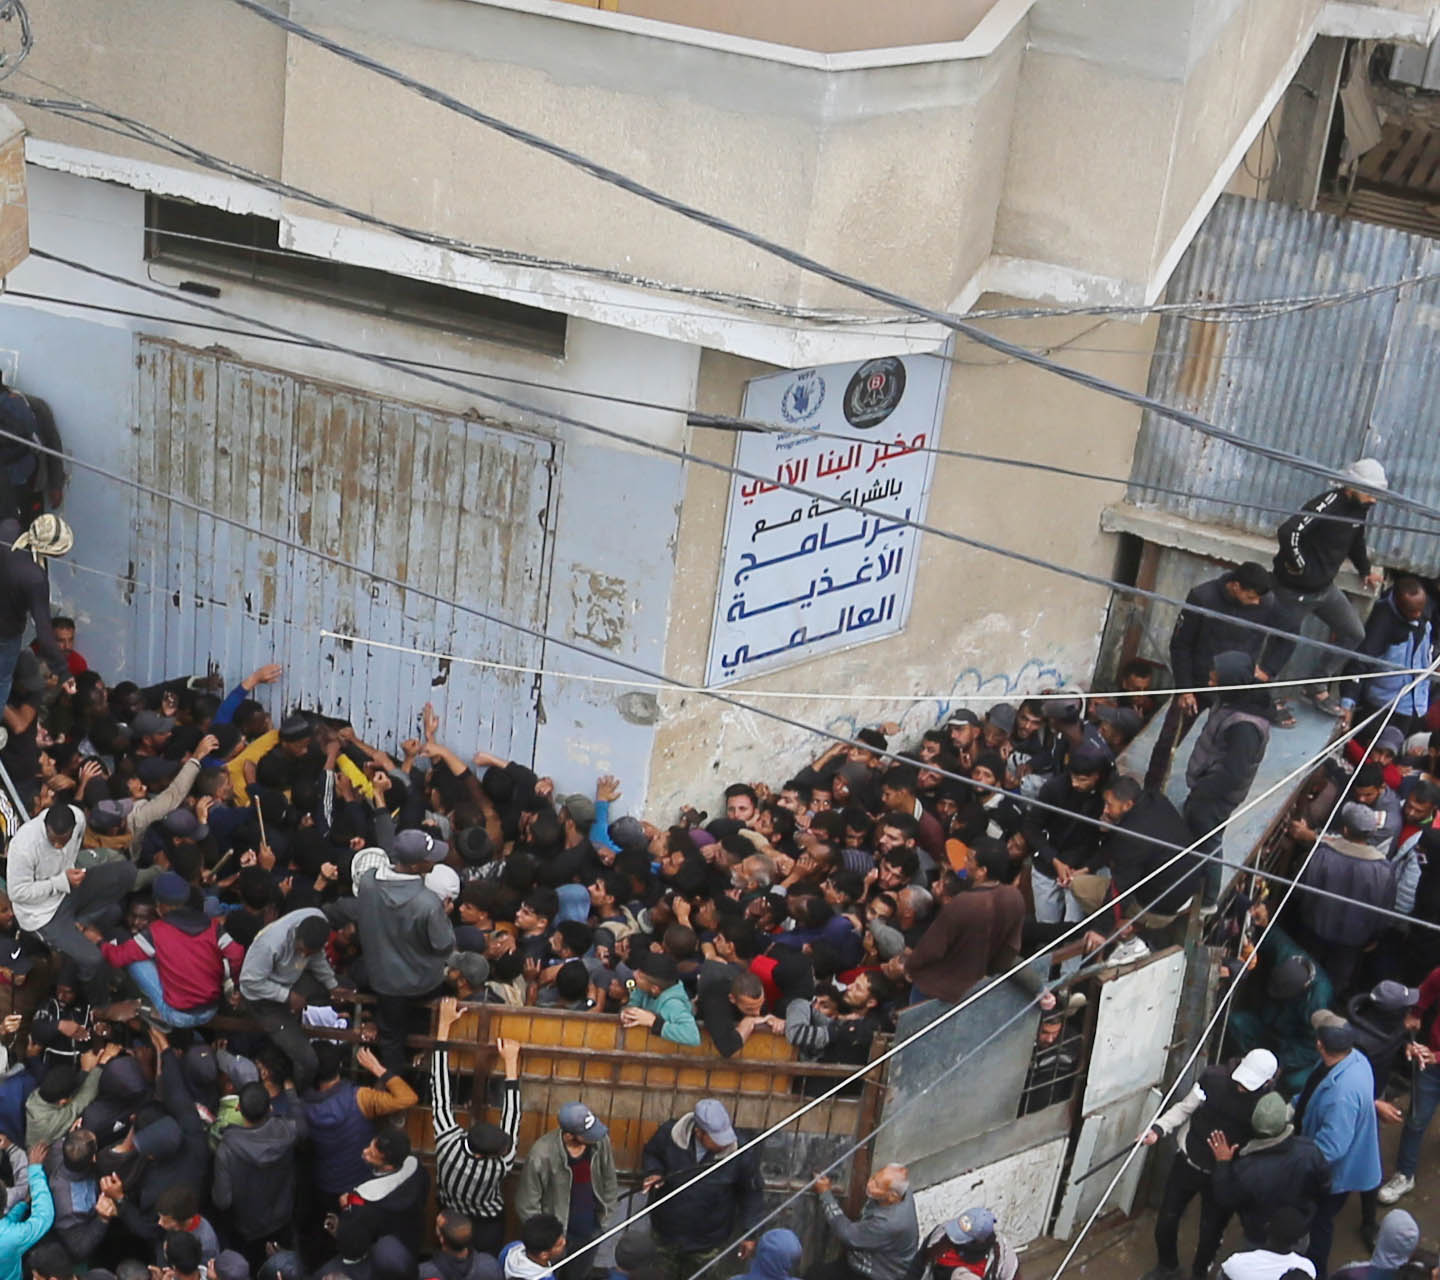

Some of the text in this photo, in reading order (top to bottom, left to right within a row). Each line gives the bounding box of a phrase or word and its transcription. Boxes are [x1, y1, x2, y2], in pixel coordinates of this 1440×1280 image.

[816, 443, 864, 480] البنا
[866, 432, 927, 475] مخبز
[751, 478, 903, 543] بالشراكة مع
[727, 543, 904, 623] الأغذية
[734, 508, 912, 587] برنامج
[721, 593, 897, 677] العالمي
